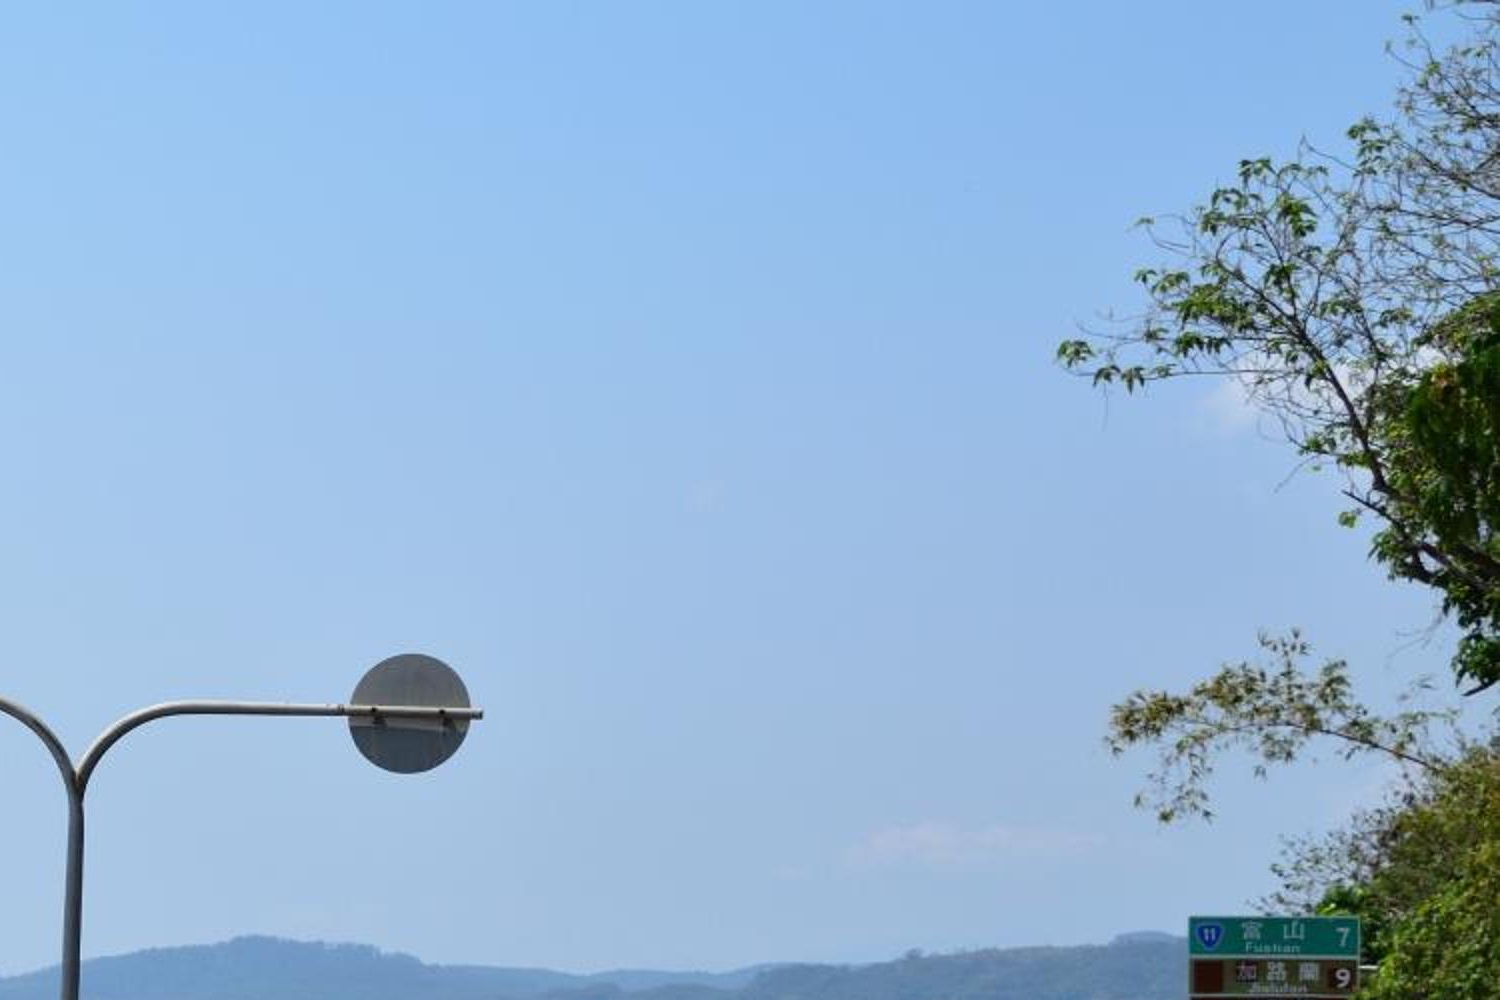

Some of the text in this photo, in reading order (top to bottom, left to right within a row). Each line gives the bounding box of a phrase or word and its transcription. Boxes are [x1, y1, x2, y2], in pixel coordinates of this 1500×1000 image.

[1203, 928, 1216, 942] 11
[1241, 920, 1305, 940] 富山
[1336, 928, 1350, 947] 7
[1336, 968, 1350, 988] 9
